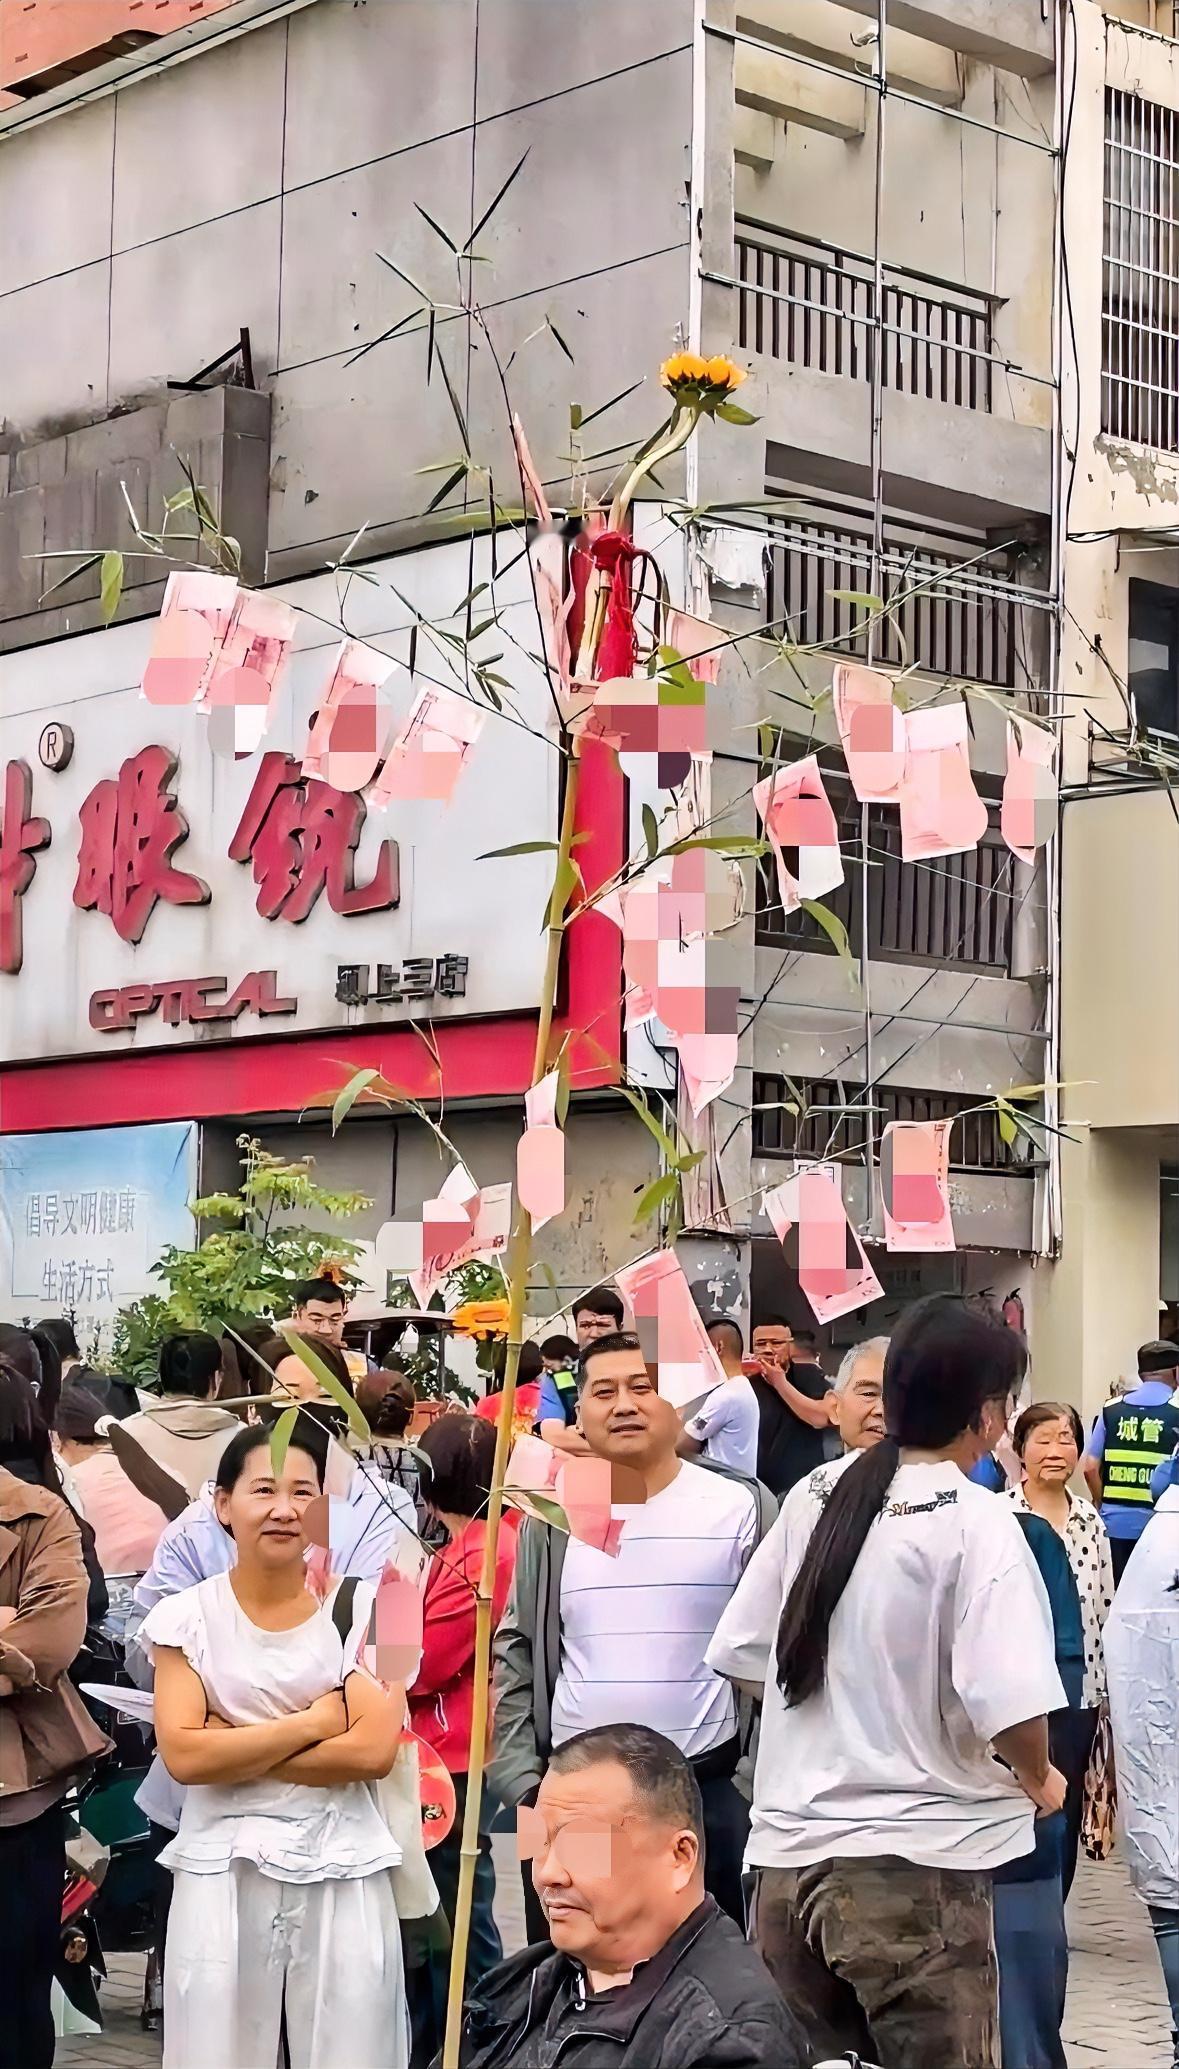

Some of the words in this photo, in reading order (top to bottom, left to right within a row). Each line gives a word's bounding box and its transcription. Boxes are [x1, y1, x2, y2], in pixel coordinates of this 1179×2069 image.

[89, 970, 297, 1032] OPTICAL
[26, 1189, 137, 1238] 倡导文明健康
[40, 1258, 115, 1303] 生活方式
[1116, 1415, 1165, 1443] 城管
